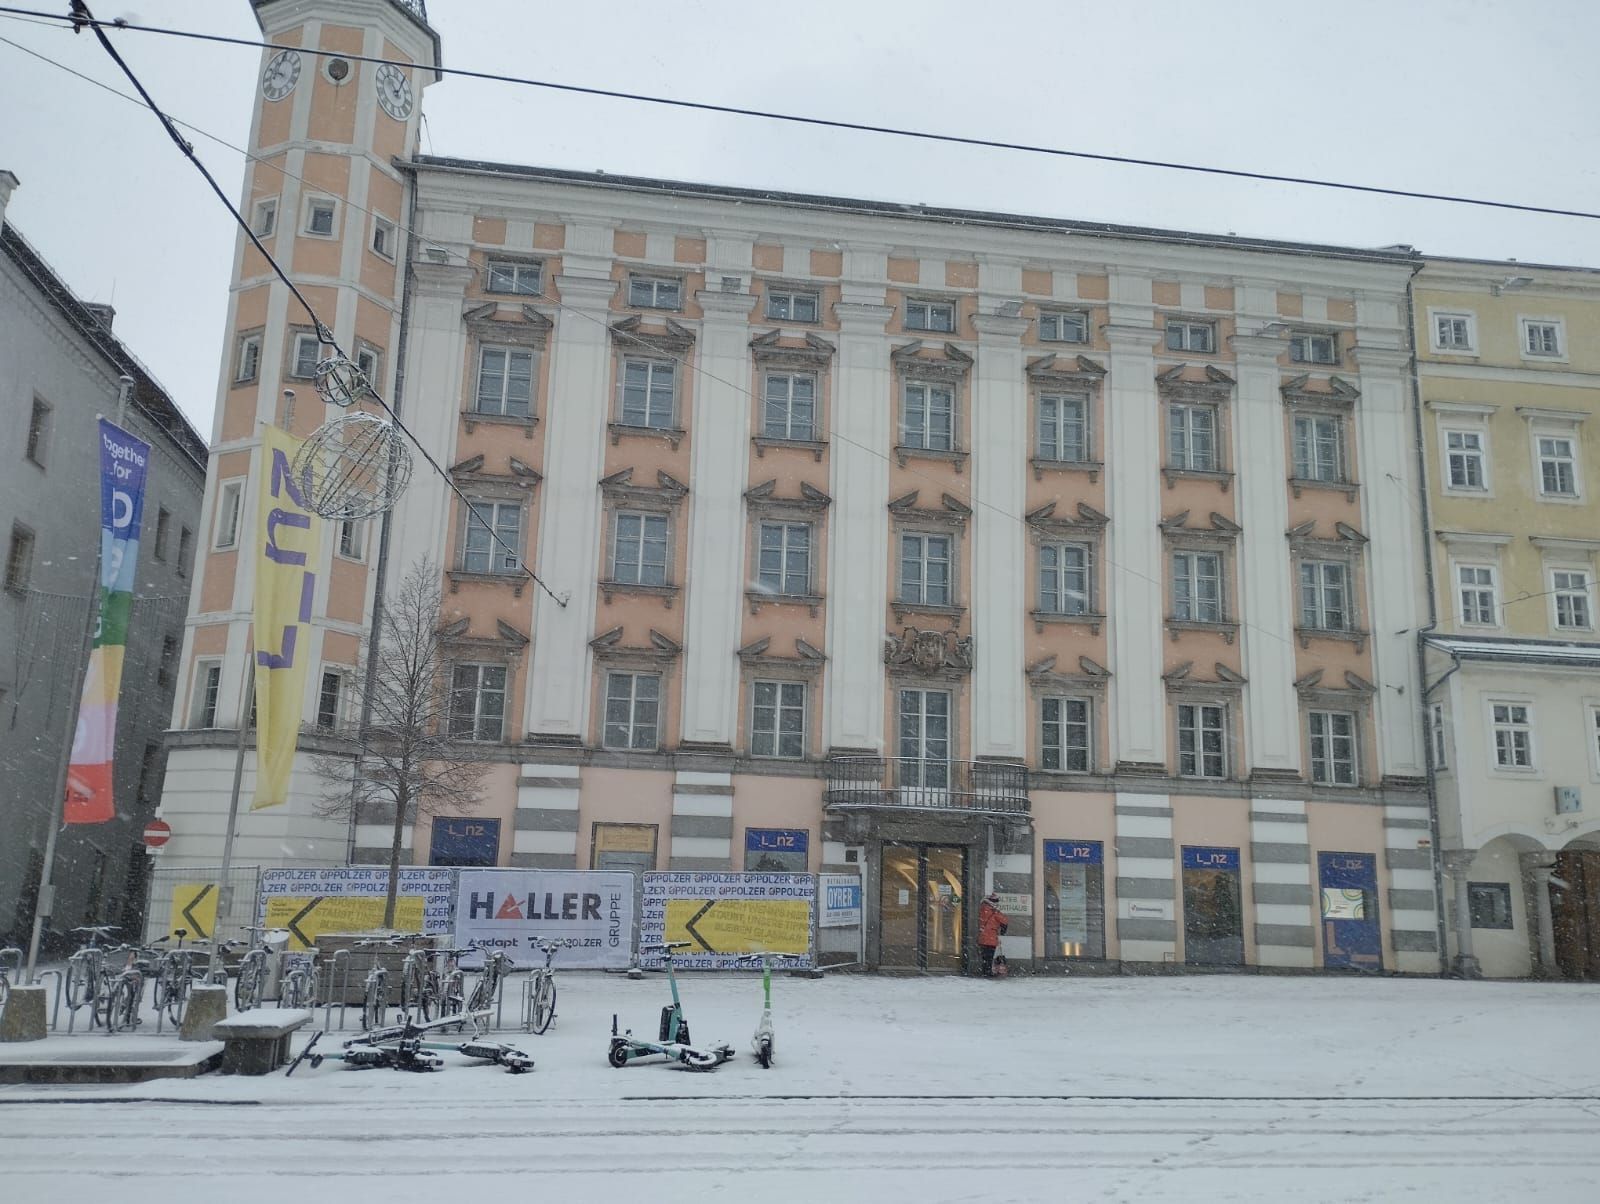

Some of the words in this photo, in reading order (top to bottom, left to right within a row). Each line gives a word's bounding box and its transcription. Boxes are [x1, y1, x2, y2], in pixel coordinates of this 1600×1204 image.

[112, 460, 132, 479] for
[470, 891, 602, 920] HALLER
[609, 892, 621, 947] GRUPPE
